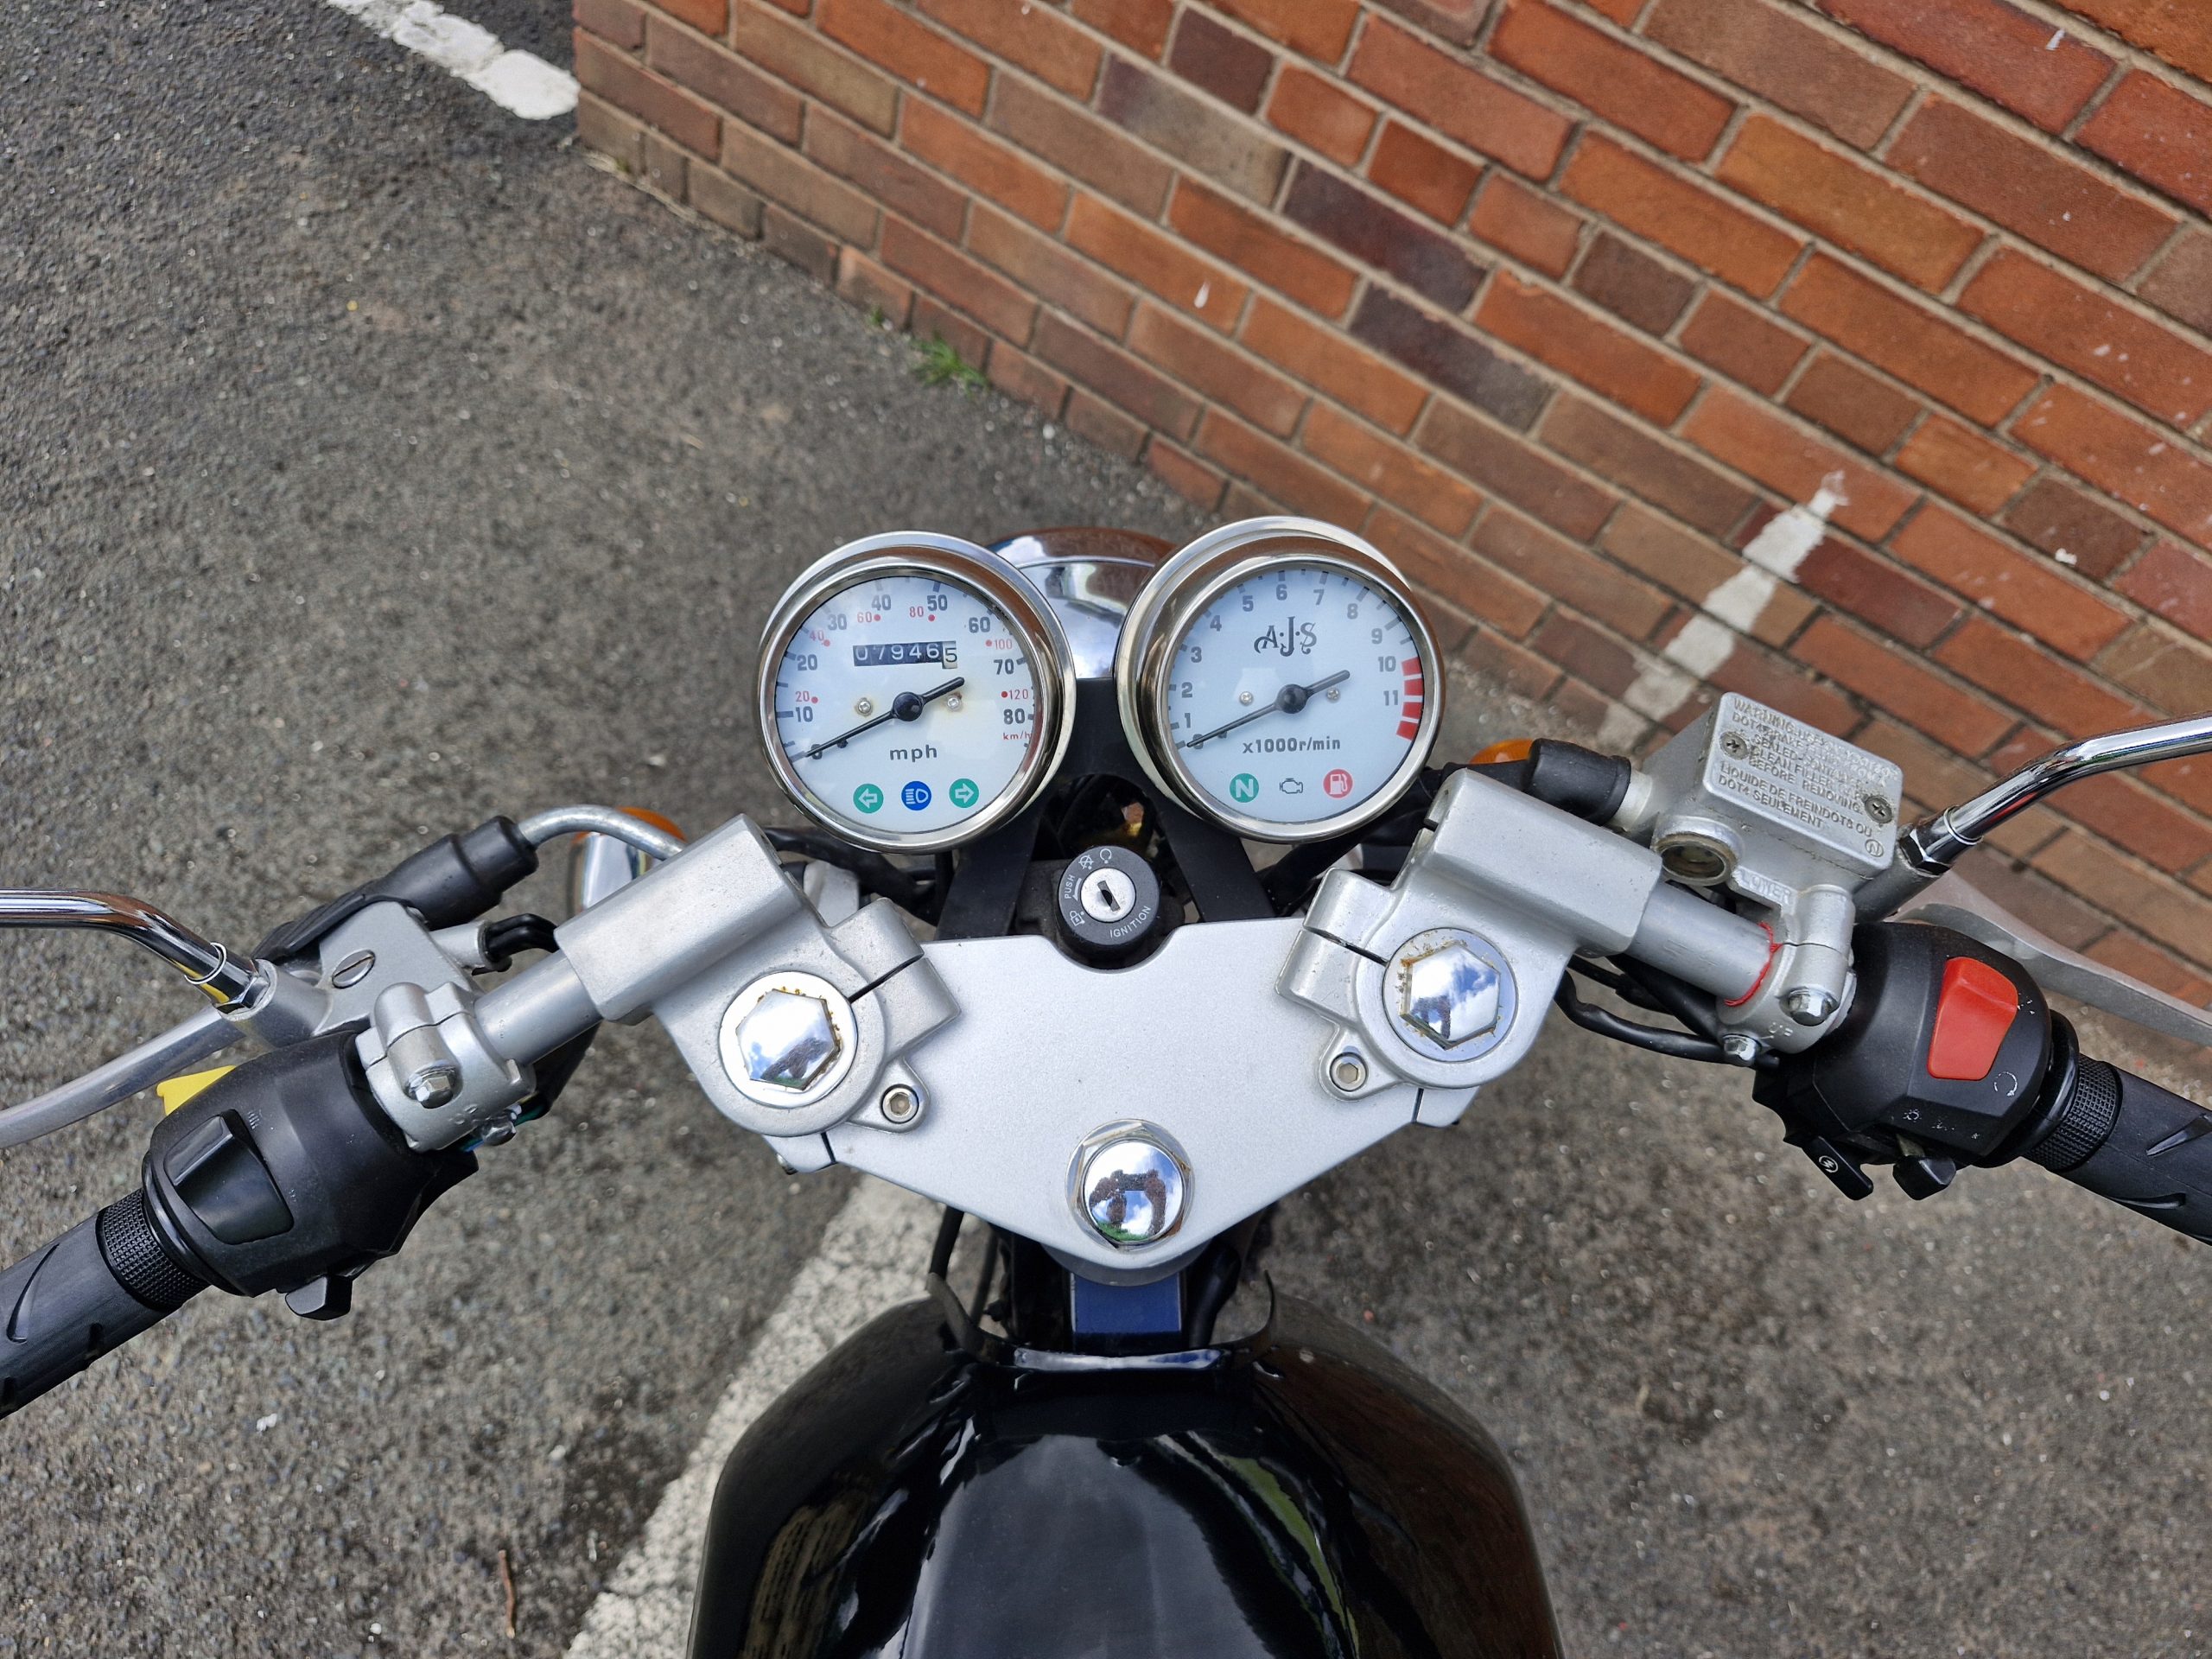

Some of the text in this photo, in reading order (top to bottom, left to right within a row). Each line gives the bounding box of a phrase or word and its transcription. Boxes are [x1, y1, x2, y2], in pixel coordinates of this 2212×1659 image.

[1275, 584, 1287, 600] 6
[1313, 589, 1324, 605] 7
[871, 594, 892, 611] 40
[926, 594, 948, 611] 50
[1243, 595, 1254, 612] 5
[857, 612, 872, 623] 60
[909, 607, 924, 618] 80
[1347, 603, 1358, 620] 8
[828, 614, 847, 630] 30
[969, 617, 990, 632] 60
[1210, 615, 1222, 631] 4
[810, 631, 824, 642] 40
[1371, 628, 1382, 644] 9
[995, 639, 1013, 650] 100
[797, 655, 817, 671] 20
[1191, 647, 1202, 663] 3
[995, 658, 1014, 674] 70
[1378, 656, 1395, 672] 10
[796, 691, 810, 702] 20
[1009, 690, 1029, 700] 120
[1181, 682, 1192, 698] 2
[1383, 690, 1398, 706] 11
[796, 707, 813, 722] 10
[1003, 709, 1026, 724] 80
[1185, 713, 1191, 728] 1
[1243, 737, 1340, 753] x1000r/min
[889, 745, 938, 762] mph
[1235, 779, 1254, 797] N
[1065, 874, 1075, 899] PUSH
[1109, 906, 1151, 938] IGNITION
